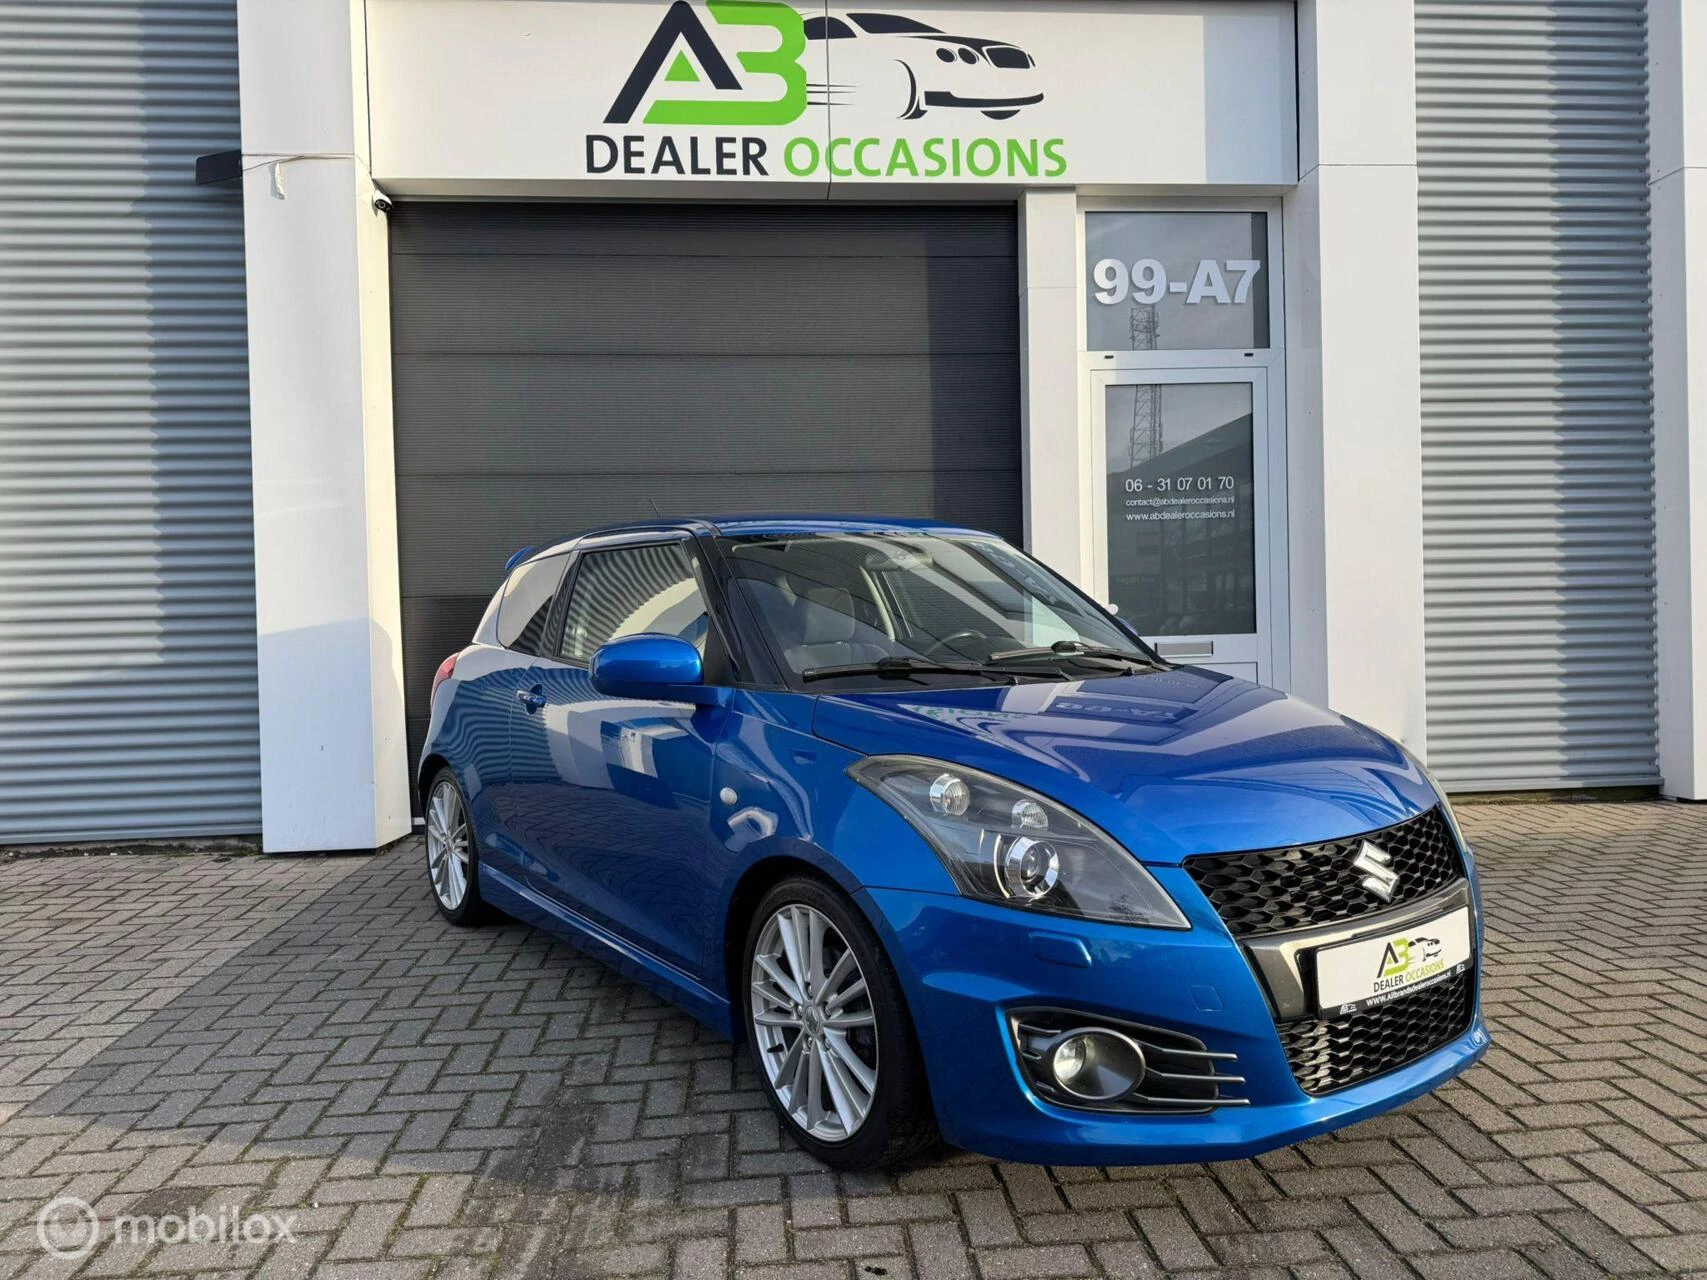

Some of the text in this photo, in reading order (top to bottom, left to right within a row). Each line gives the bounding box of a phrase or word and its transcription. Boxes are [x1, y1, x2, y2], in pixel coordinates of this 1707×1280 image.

[586, 135, 1068, 177] DEALER OCCASIONS
[1093, 258, 1261, 305] 99-A7
[1125, 478, 1143, 493] 06
[1157, 477, 1171, 491] 31
[1177, 477, 1193, 491] 07
[1197, 476, 1212, 490] 01
[1218, 475, 1234, 489] 70
[1126, 510, 1235, 521] www.abdealeroccasions.nl
[1373, 974, 1404, 993] DEALER
[1405, 959, 1445, 982] OCCASIONS
